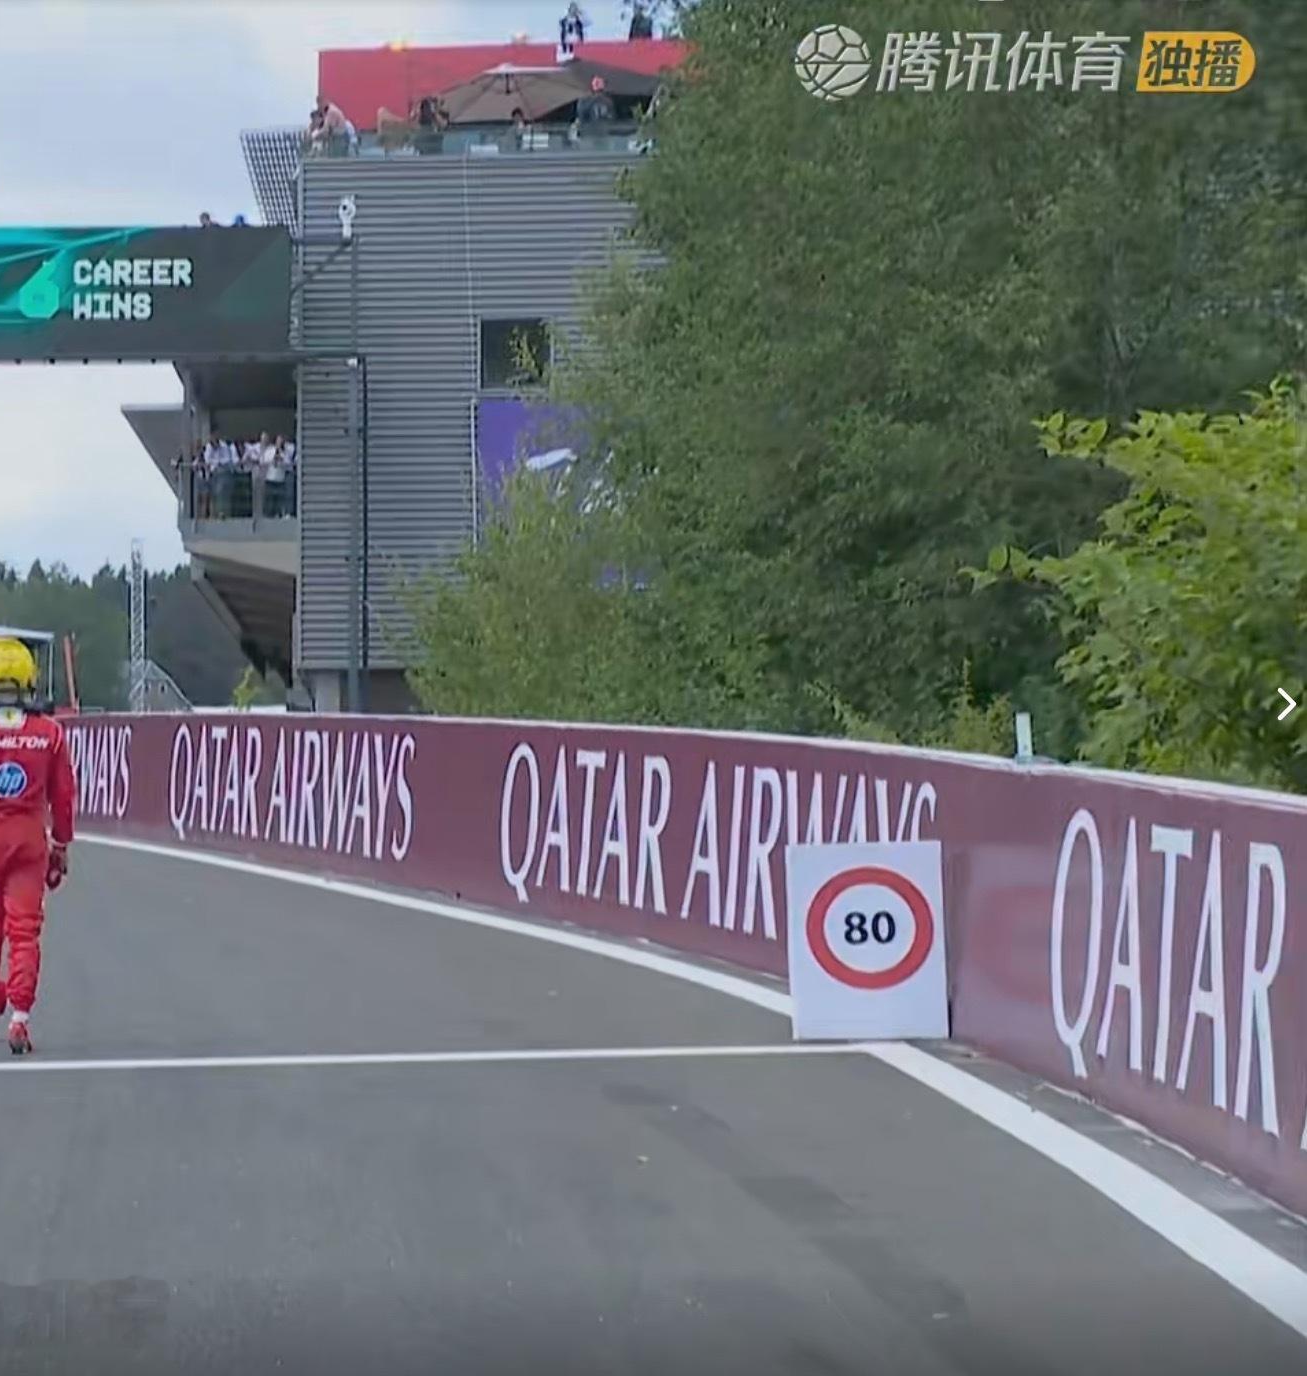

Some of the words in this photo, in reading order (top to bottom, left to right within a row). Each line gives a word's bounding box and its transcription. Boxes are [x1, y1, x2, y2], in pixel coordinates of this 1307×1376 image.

[73, 259, 193, 286] CAREER
[73, 292, 153, 320] WINS
[66, 725, 132, 818] RWAYS
[170, 722, 263, 841] QATAR
[265, 725, 416, 862] AIRWAYS
[500, 741, 673, 918] QATAR
[843, 910, 896, 945] 80
[1050, 807, 1287, 1139] QATAR
